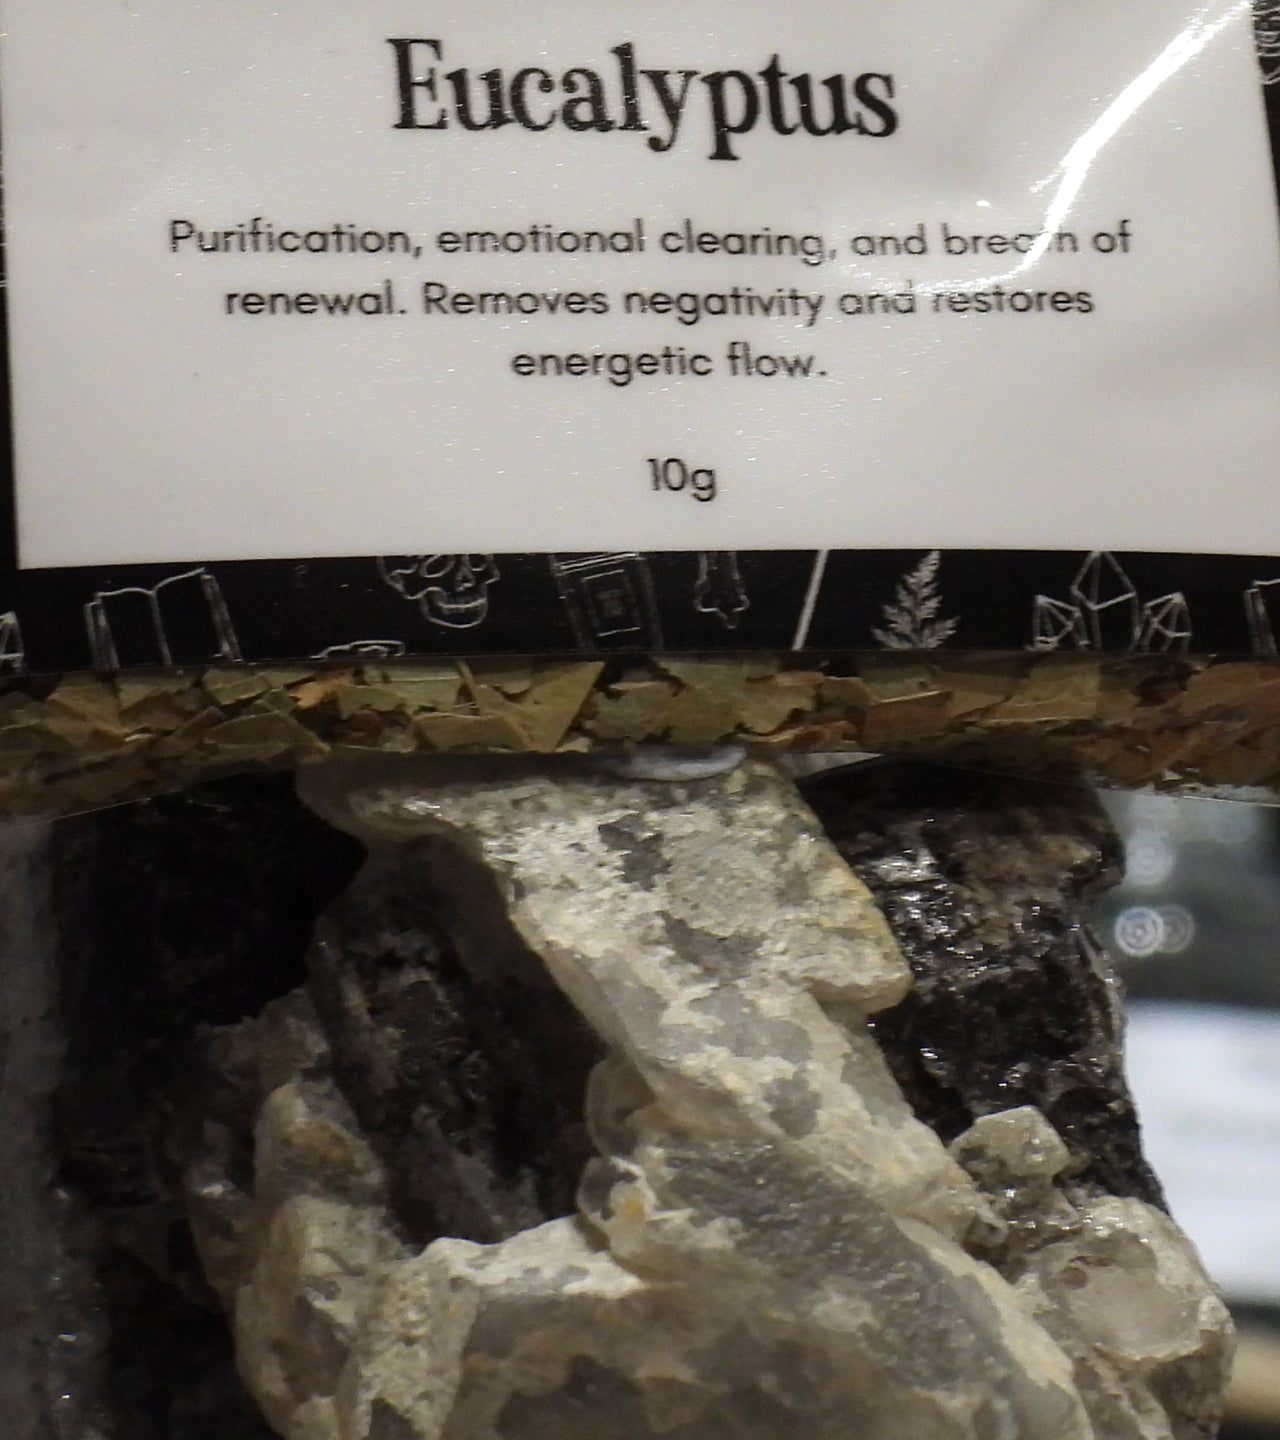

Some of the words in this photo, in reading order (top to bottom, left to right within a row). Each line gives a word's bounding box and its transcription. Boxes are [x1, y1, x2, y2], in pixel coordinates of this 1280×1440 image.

[385, 37, 899, 160] Eucalyptus
[169, 218, 422, 258] Purification,
[436, 218, 643, 254] emotional
[660, 219, 837, 265] clearing,
[852, 224, 926, 255] and
[1091, 220, 1131, 254] of
[225, 279, 406, 316] renewal.
[424, 282, 609, 315] Removes
[624, 285, 824, 326] negativity
[838, 280, 916, 315] and
[932, 287, 1094, 313] restores
[511, 346, 713, 386] energetic
[727, 342, 826, 376] flow.
[647, 458, 716, 502] 10g
